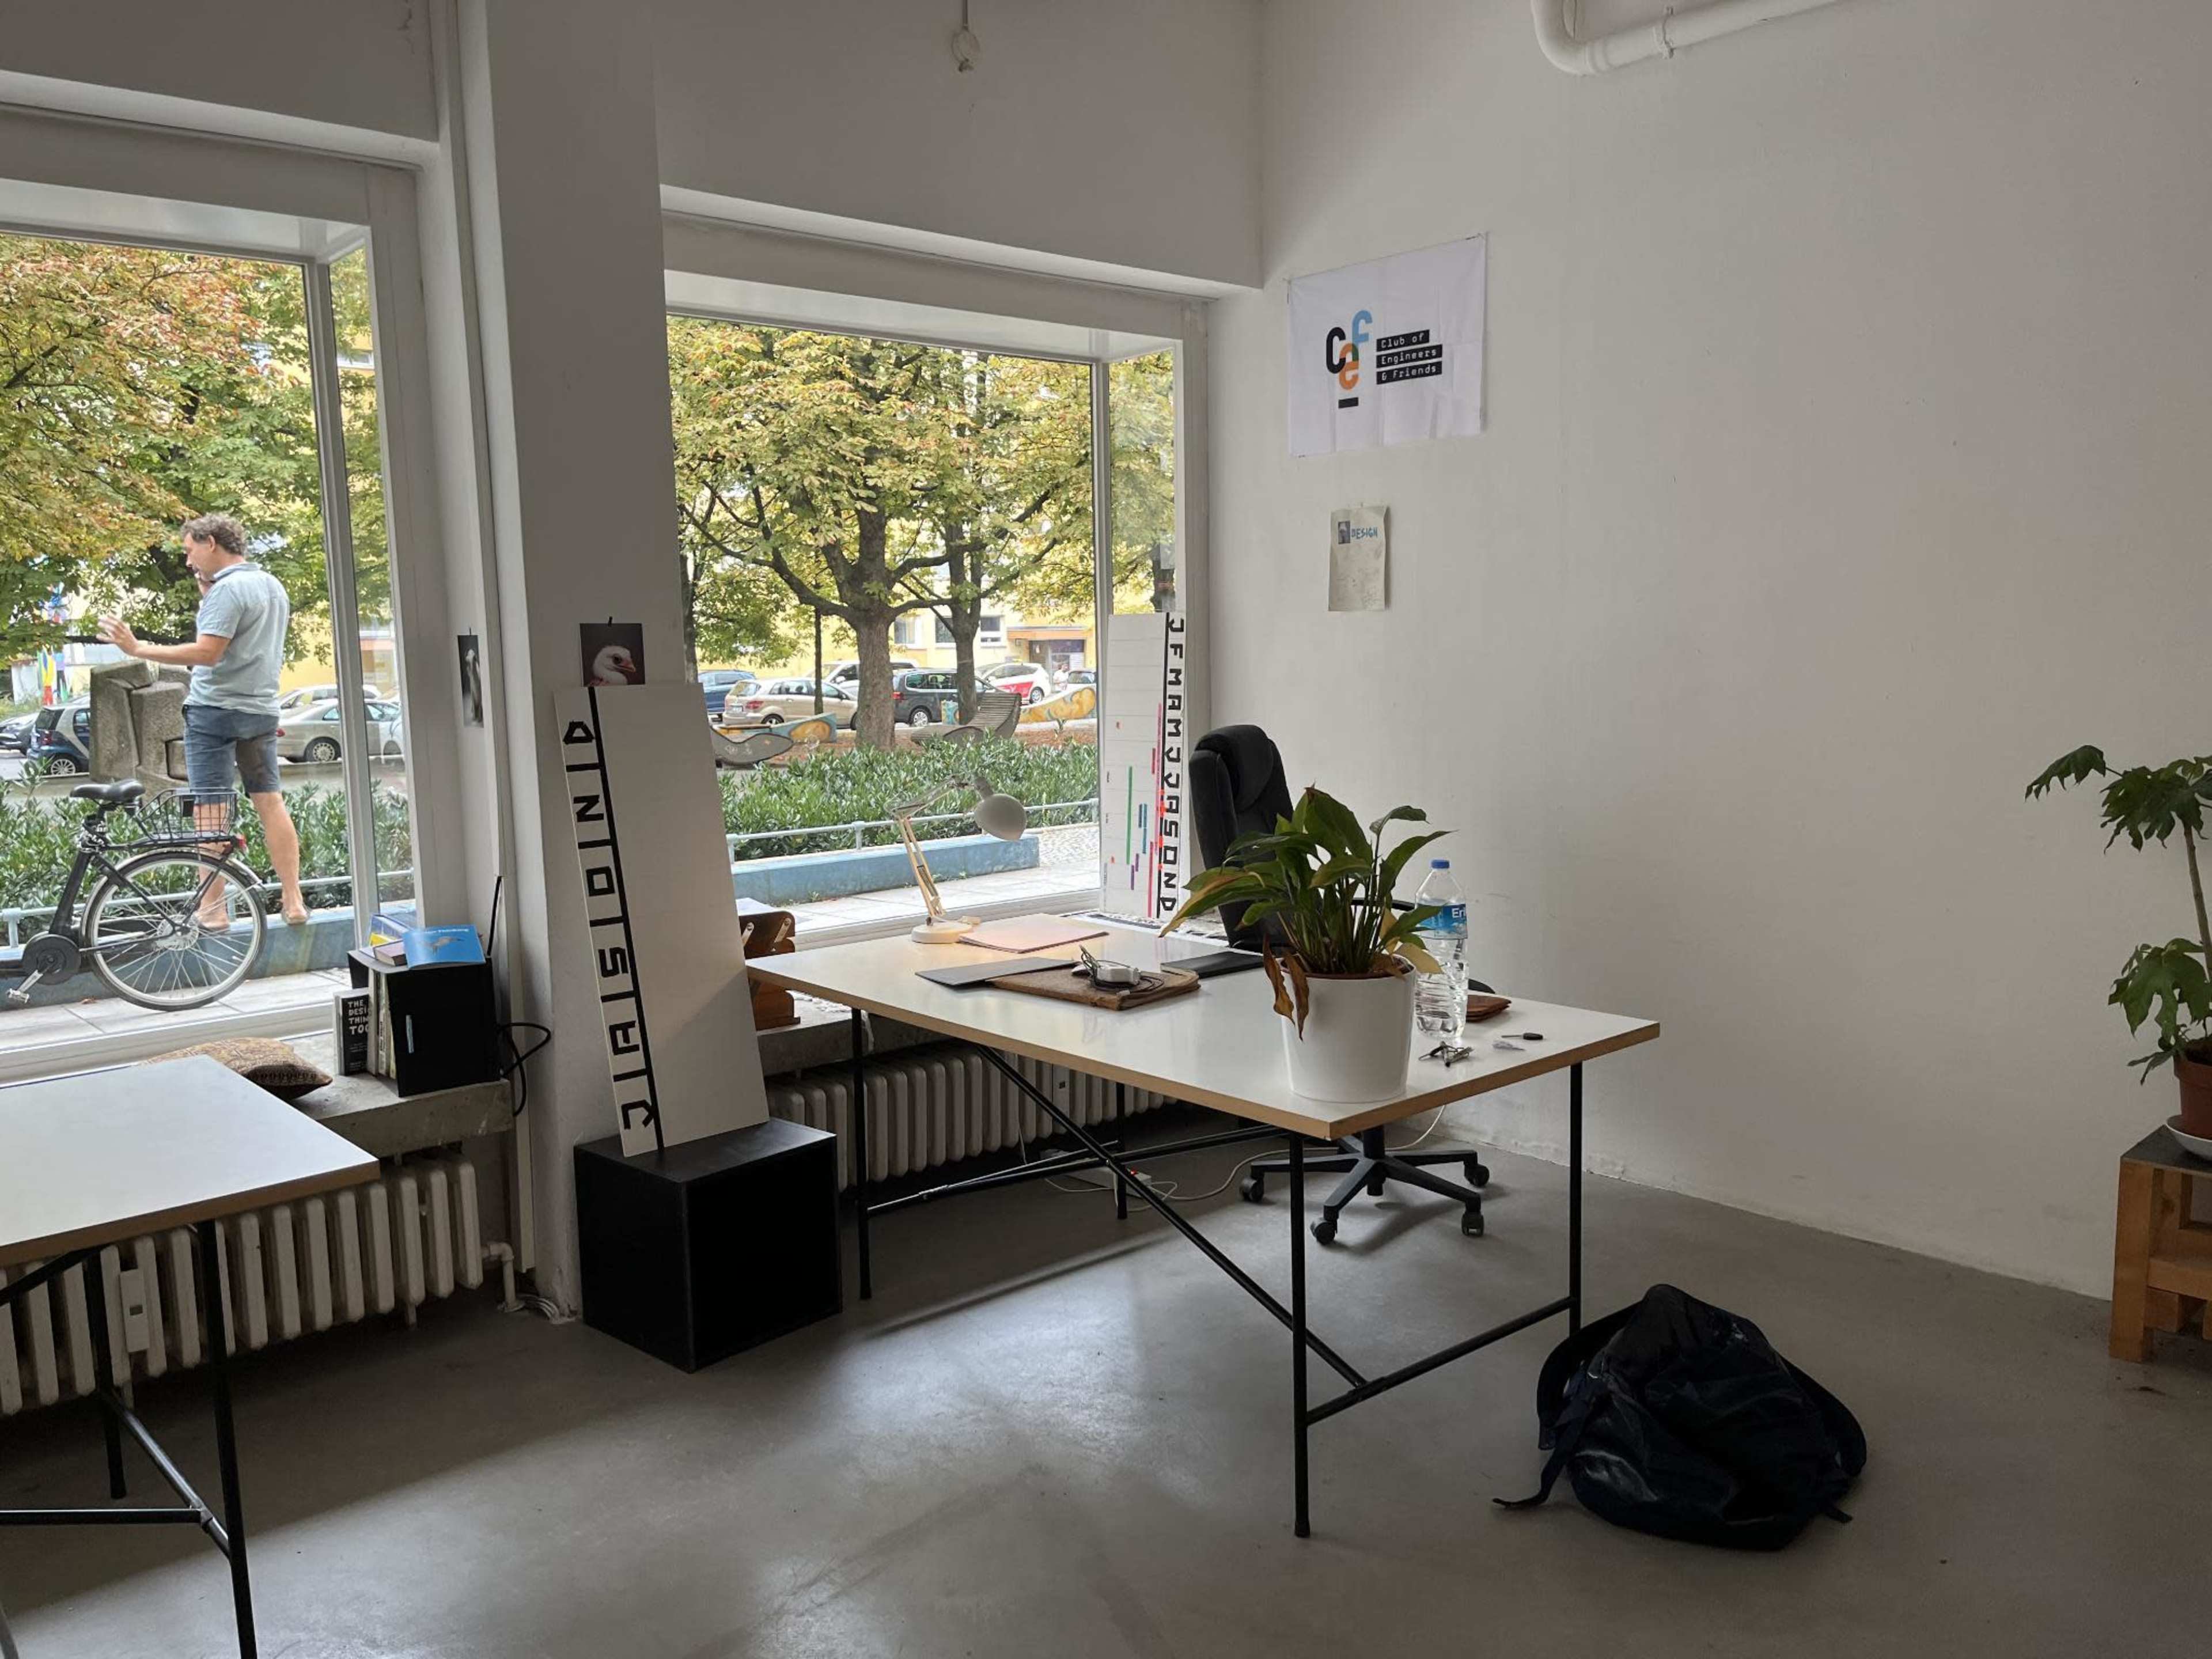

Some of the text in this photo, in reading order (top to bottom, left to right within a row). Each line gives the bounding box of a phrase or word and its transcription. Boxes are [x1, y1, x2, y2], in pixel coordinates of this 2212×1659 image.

[1381, 332, 1425, 349] Club of
[1381, 349, 1437, 365] Engineers
[347, 999, 363, 1008] THE
[349, 1005, 369, 1016] DESI
